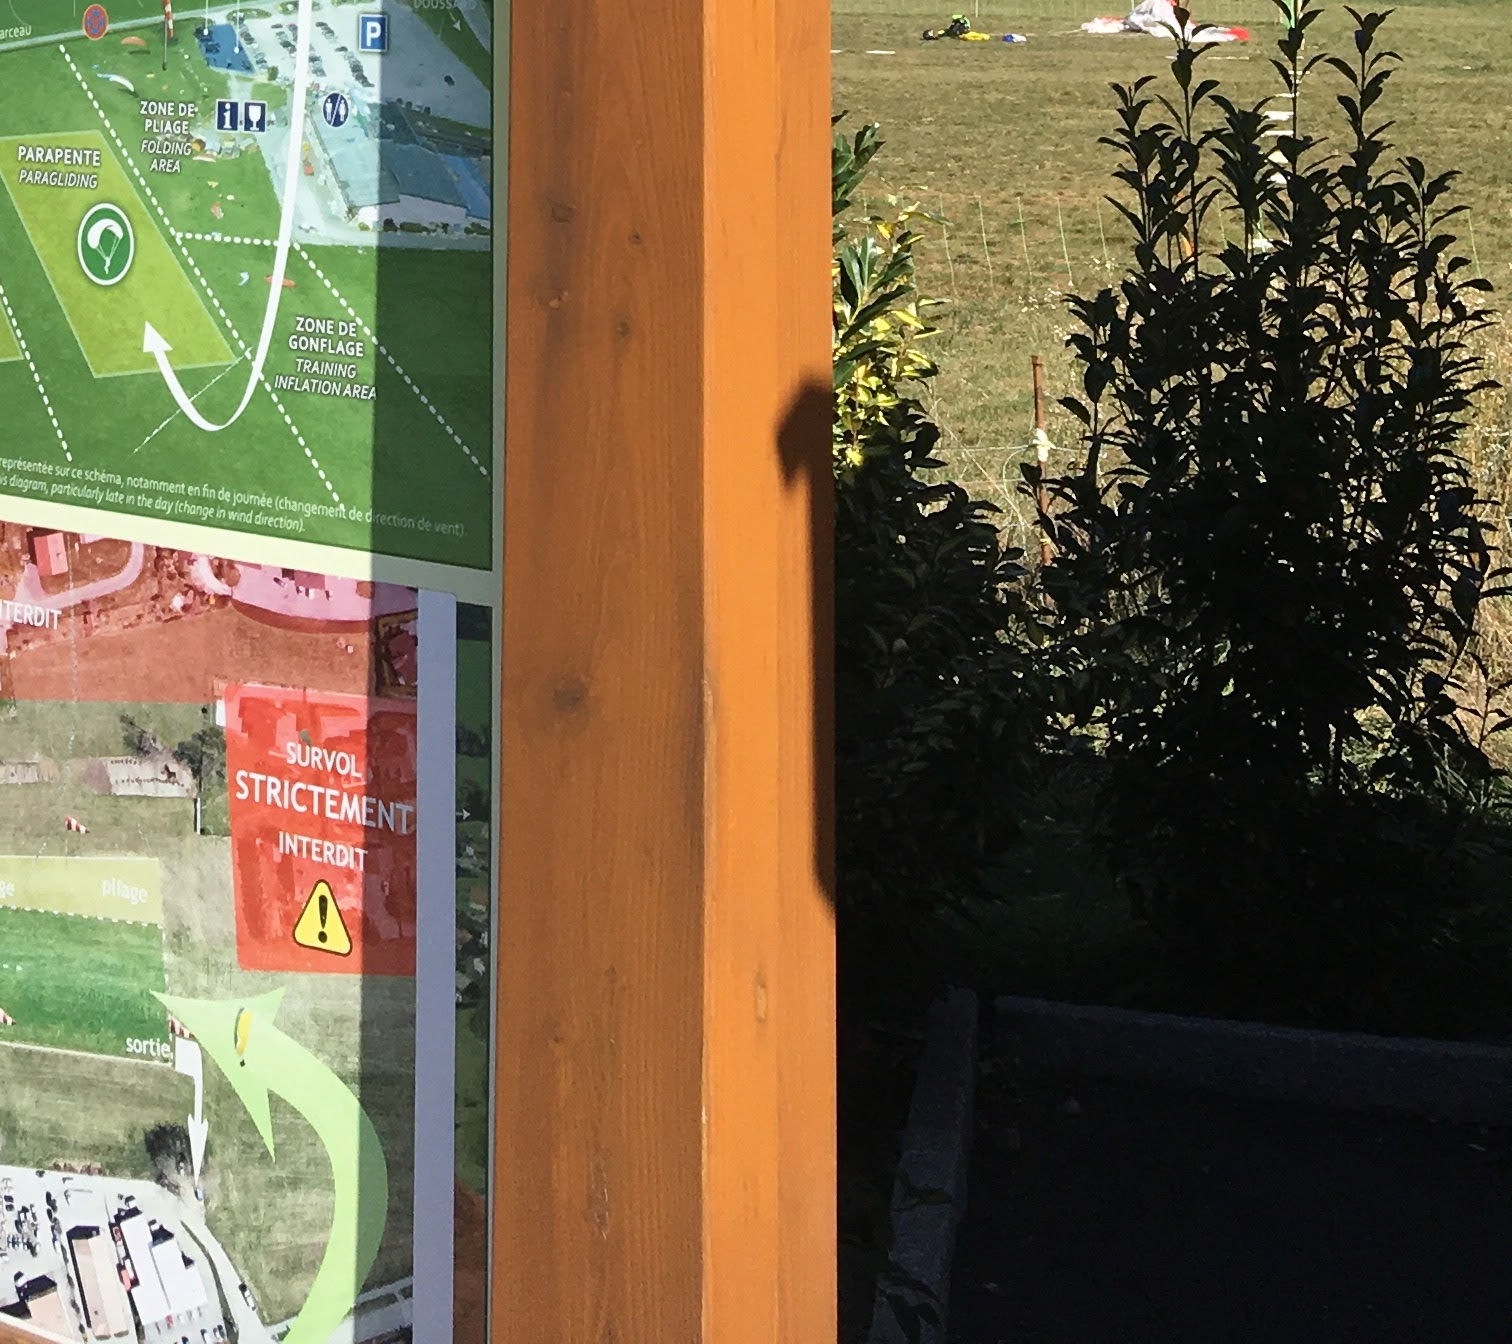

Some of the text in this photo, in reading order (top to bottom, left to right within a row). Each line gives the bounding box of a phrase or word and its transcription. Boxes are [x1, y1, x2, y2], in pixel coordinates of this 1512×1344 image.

[366, 23, 382, 47] P
[140, 101, 195, 117] ZONE DE
[145, 120, 189, 135] PLIAGE
[17, 146, 100, 167] PARAPENTE
[140, 139, 192, 157] FOLDING
[150, 159, 182, 174] AREA
[19, 170, 98, 189] PARAGLIDING
[296, 317, 357, 337] ZONE DE
[289, 337, 364, 357] GONFLAGE
[296, 359, 357, 379] TRAINING
[274, 375, 377, 401] INFLATION AREA
[286, 742, 363, 779] SURVOL
[236, 770, 415, 834] STRICTEMENT
[279, 831, 368, 872] INTERDIT
[102, 878, 148, 905] pliage
[126, 1034, 171, 1058] sortie
